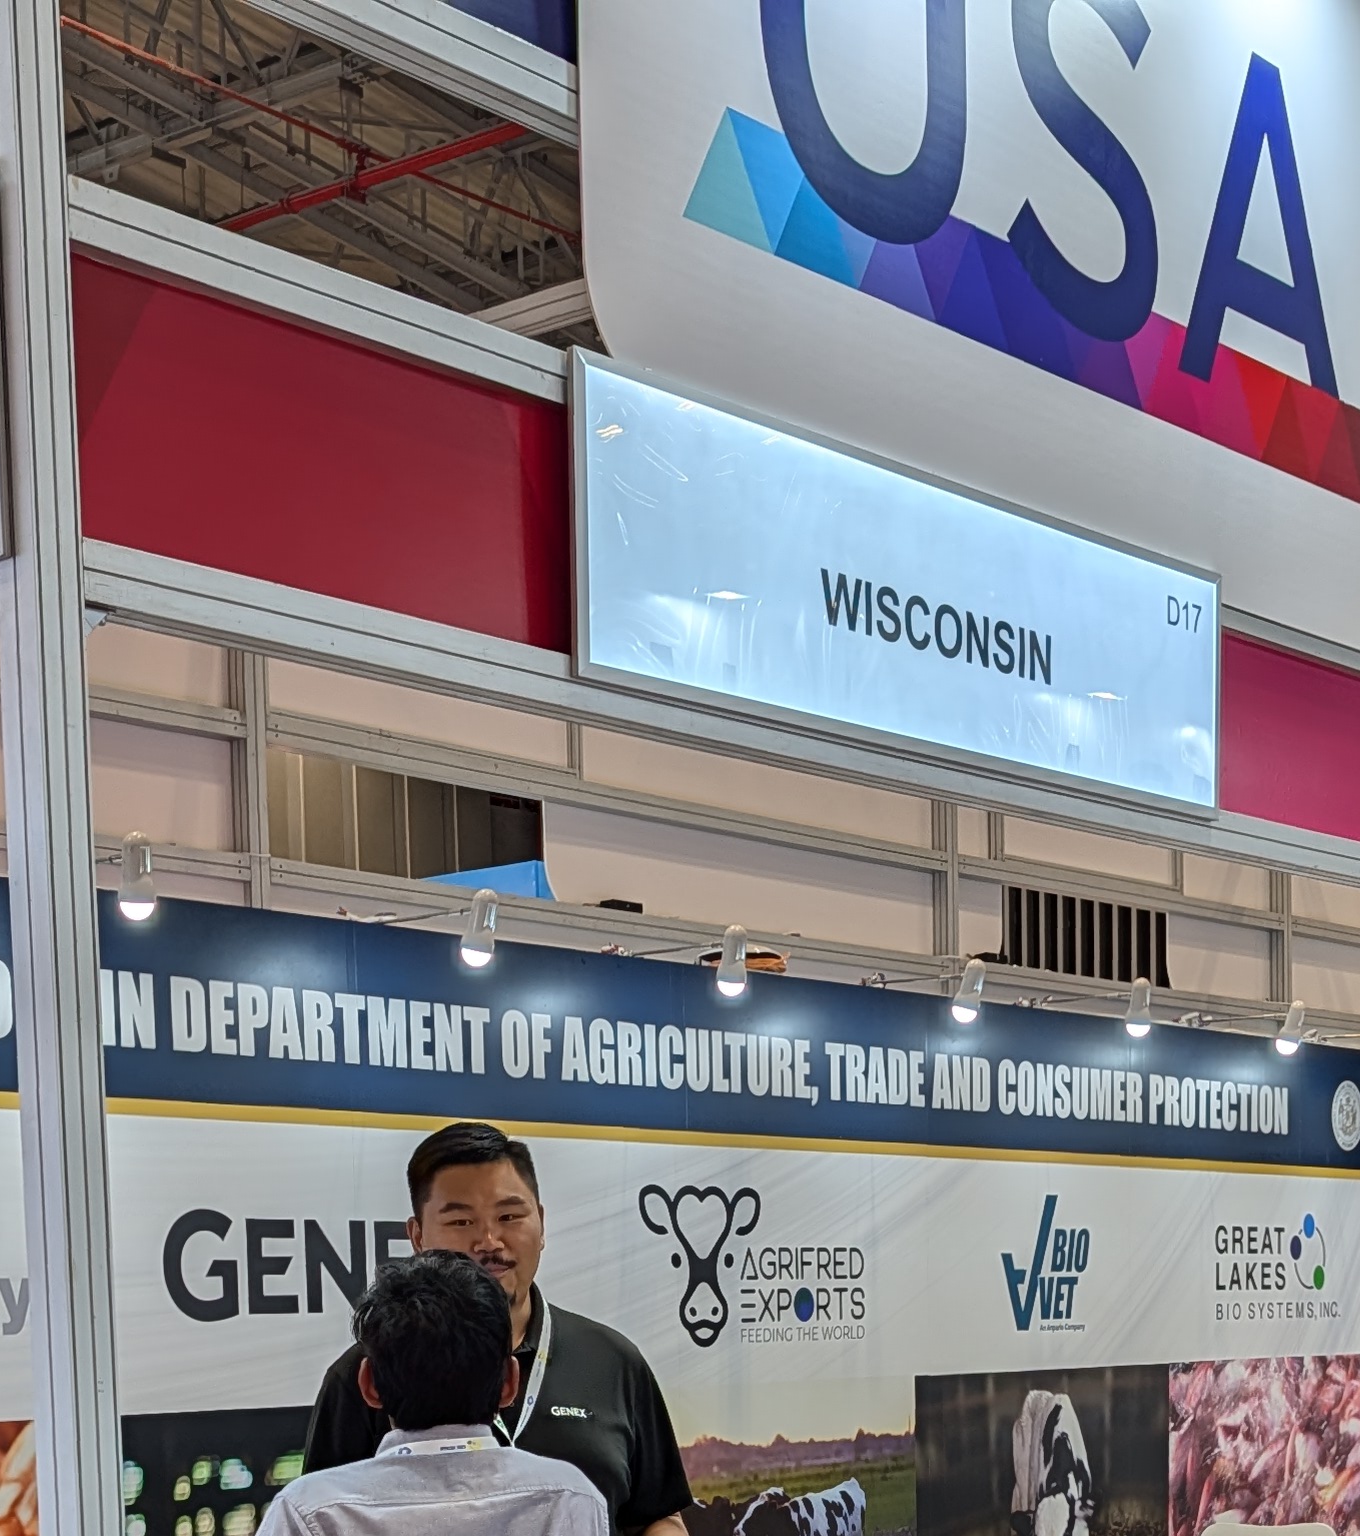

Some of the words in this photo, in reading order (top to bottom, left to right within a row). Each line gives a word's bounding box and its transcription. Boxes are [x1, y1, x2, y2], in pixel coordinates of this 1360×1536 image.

[760, 0, 1341, 401] USA
[820, 567, 1053, 686] WISCONSIN
[1165, 594, 1203, 635] D17
[170, 976, 492, 1075] DEPARTMENT
[501, 1010, 553, 1078] OF
[561, 1016, 819, 1106] AGRICULTURE,
[824, 1042, 925, 1109] TRADE
[931, 1053, 991, 1113] AND
[997, 1058, 1144, 1123] CONSUMER
[1148, 1075, 1290, 1136] PROTECTION
[1051, 1228, 1090, 1273] BIO
[1214, 1225, 1285, 1255] GREAT
[740, 1247, 864, 1280] AGRIFRED
[1215, 1262, 1286, 1290] LAKES
[740, 1287, 865, 1323] EXPORTS
[1038, 1276, 1079, 1320] VET
[1215, 1303, 1241, 1320] BIO
[1248, 1301, 1317, 1320] SYSTEMS,
[1320, 1301, 1341, 1318] INC.
[740, 1328, 793, 1343] FEEDING
[796, 1326, 819, 1341] THE
[822, 1325, 865, 1340] WORLD
[551, 1406, 587, 1418] GENEX
